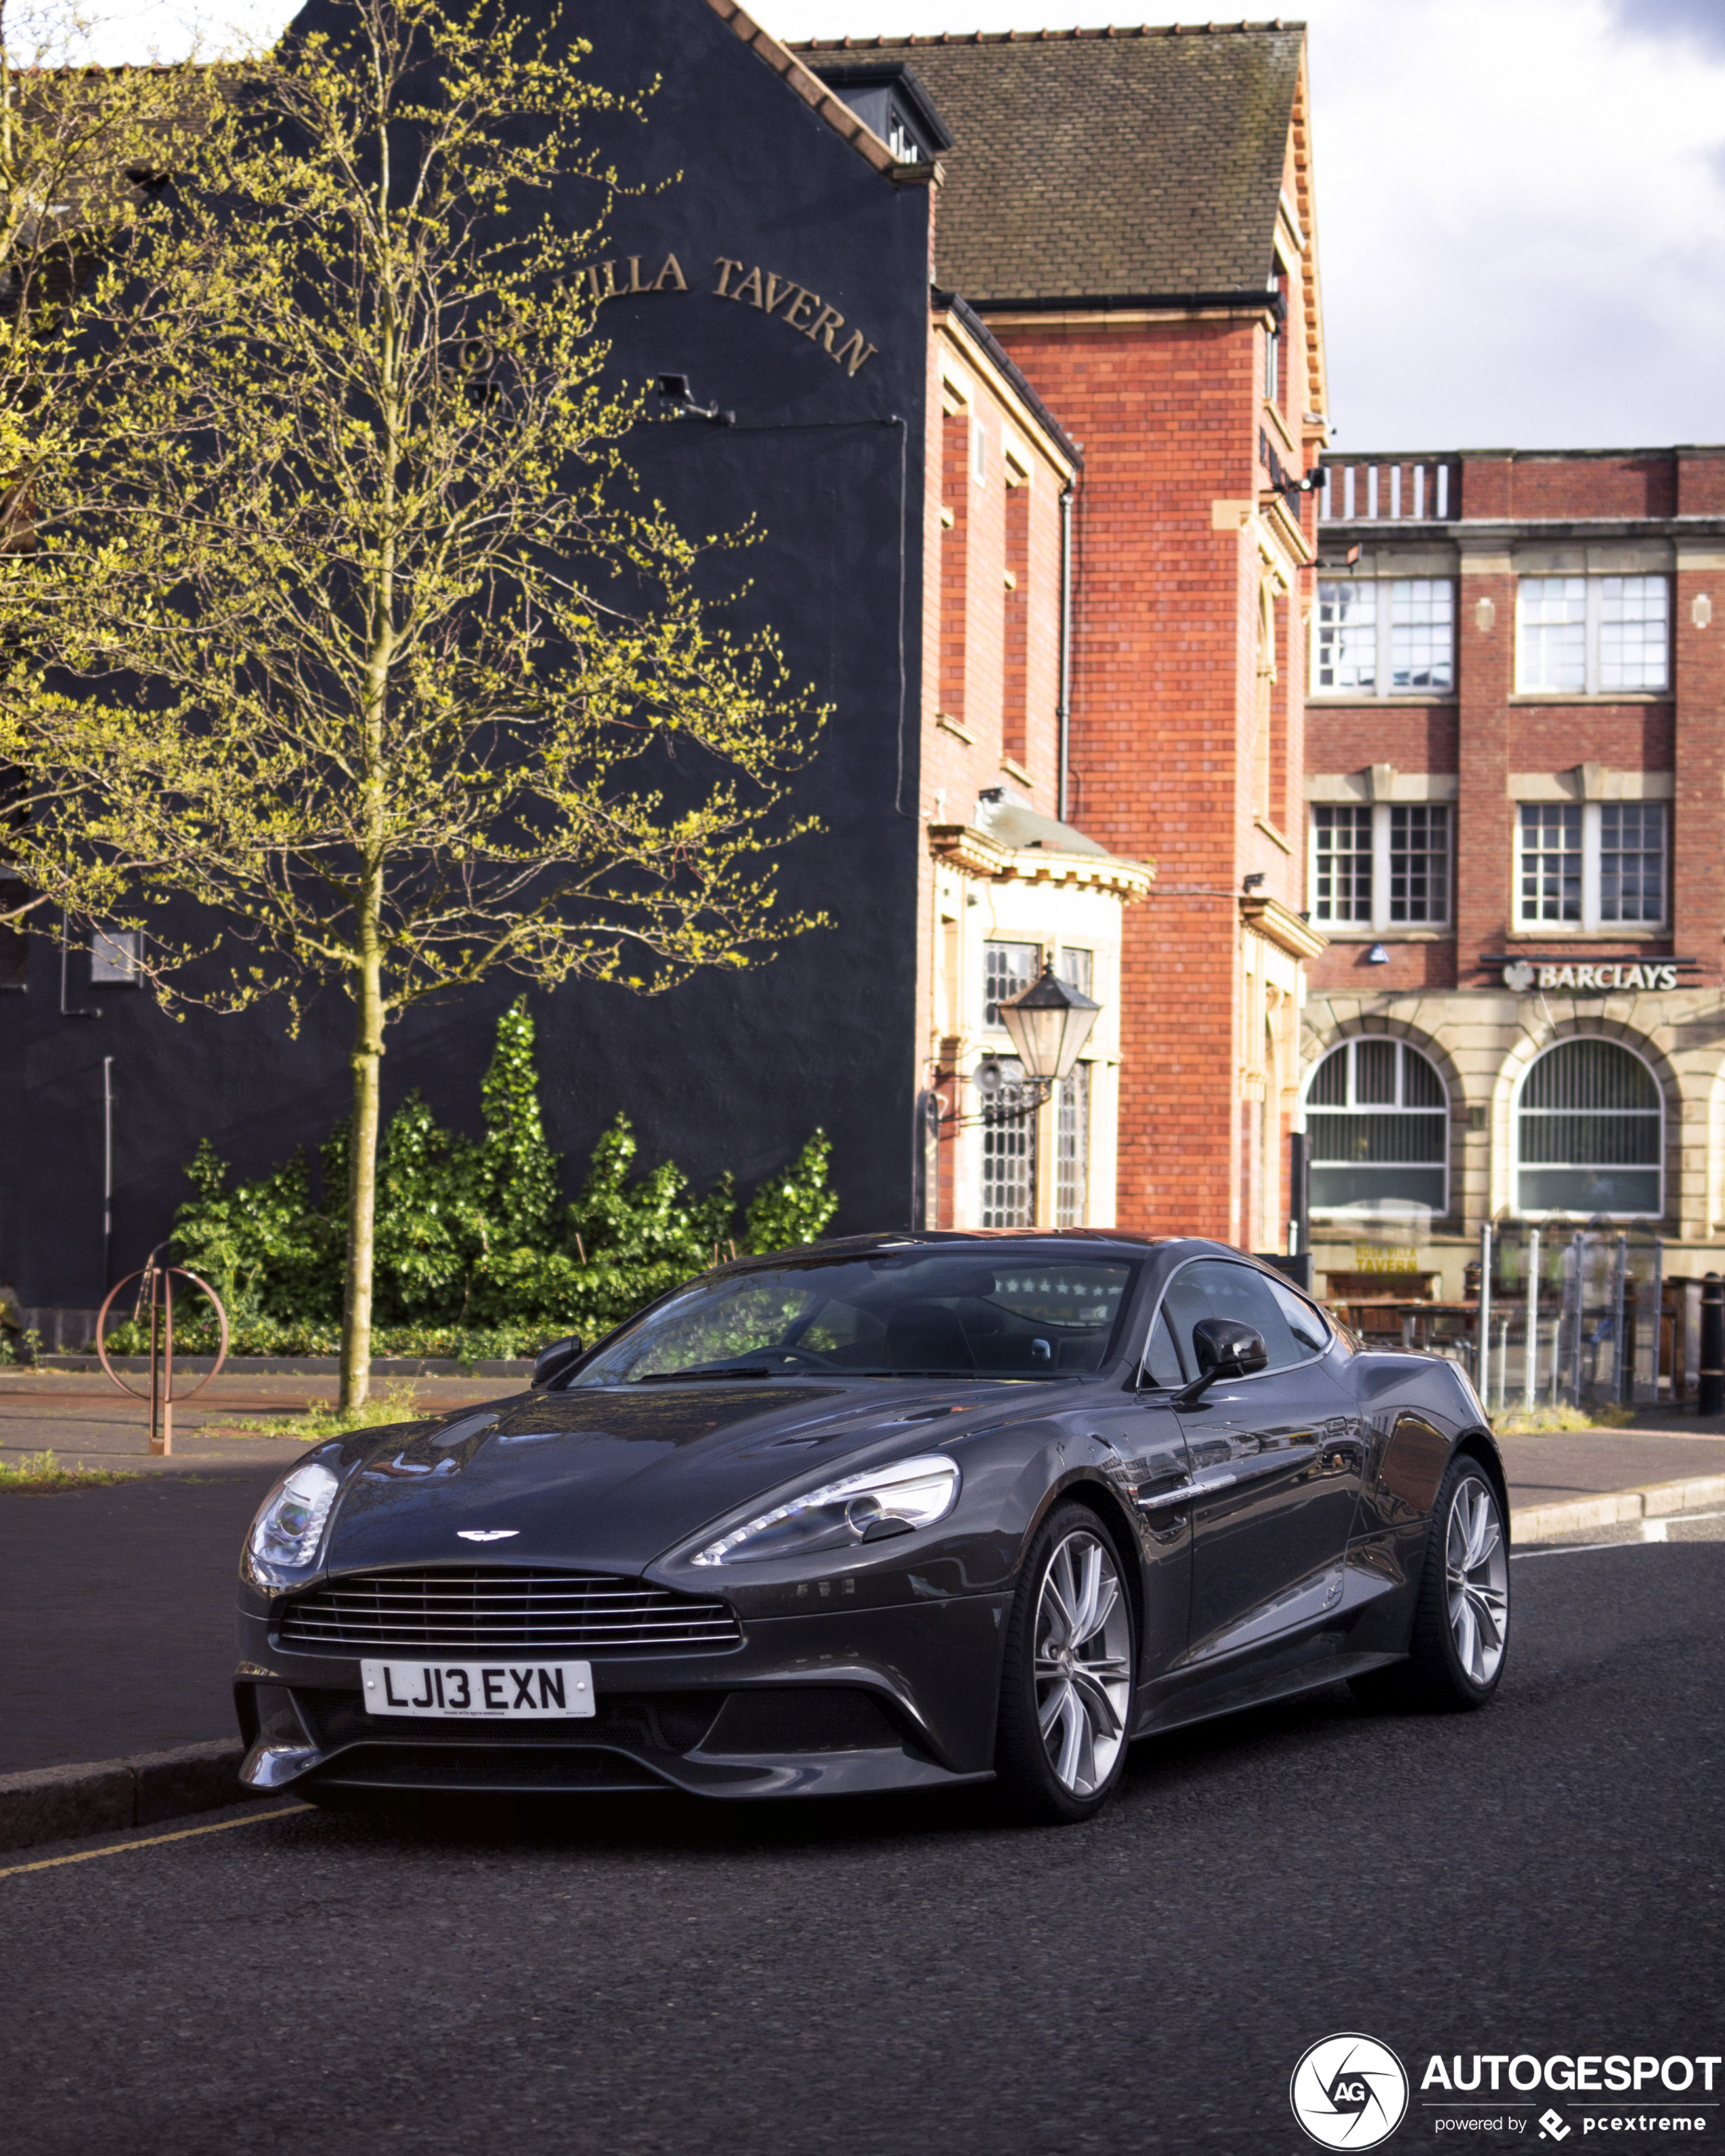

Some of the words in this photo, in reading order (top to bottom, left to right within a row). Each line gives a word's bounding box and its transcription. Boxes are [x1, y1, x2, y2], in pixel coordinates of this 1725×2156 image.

[551, 253, 688, 308] VILLA
[712, 256, 878, 377] TAVERN
[1538, 964, 1677, 990] BARCLAYS
[1356, 1246, 1382, 1257] ROSE
[1387, 1246, 1416, 1257] VILLA
[1356, 1259, 1417, 1274] TAVERN
[383, 1666, 471, 1709] LJ13
[482, 1668, 566, 1709] EXN
